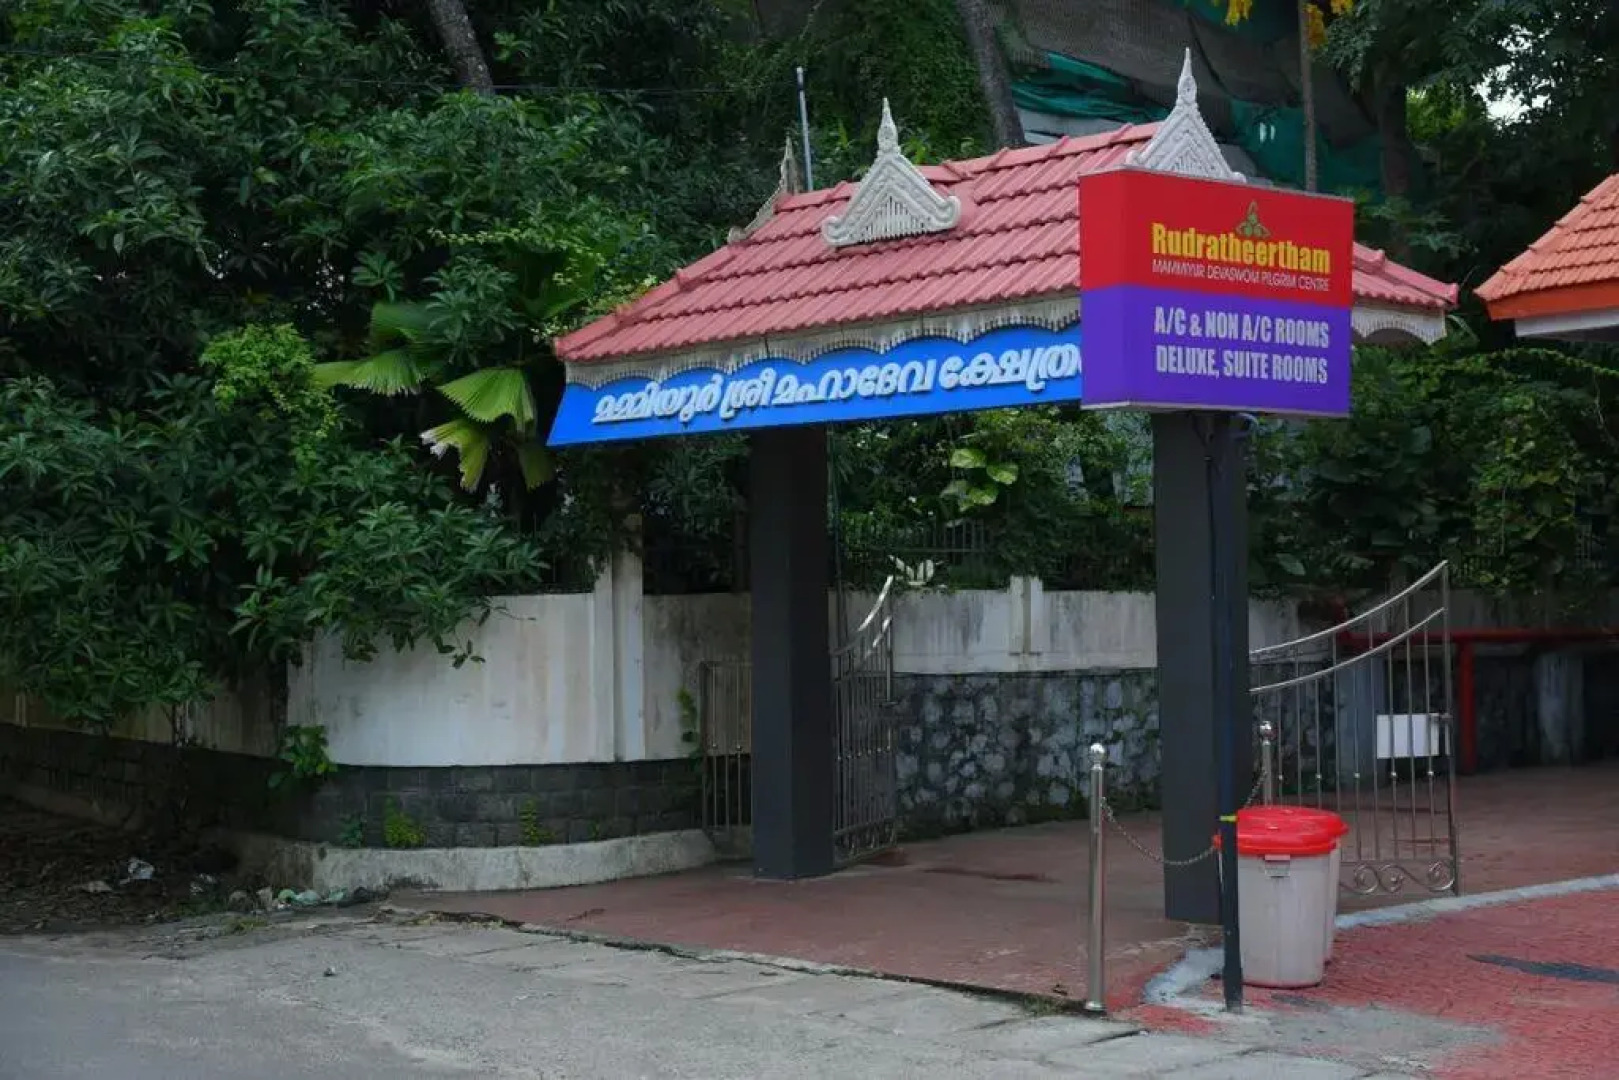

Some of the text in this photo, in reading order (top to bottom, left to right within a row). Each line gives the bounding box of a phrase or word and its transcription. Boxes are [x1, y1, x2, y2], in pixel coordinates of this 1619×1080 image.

[1152, 222, 1331, 274] Rudratheertham
[1207, 265, 1260, 284] DEVASWOM
[1261, 272, 1297, 288] PILGRIM
[1297, 276, 1329, 291] CENTRE
[1154, 306, 1329, 348] A/C & NON A/C ROOMS
[720, 367, 776, 419] ശ്രീ
[772, 359, 937, 405] മഹാദേവ
[938, 343, 1082, 392] ക്ഷേത്ര
[1156, 345, 1328, 384] DELUXE, SUITE ROOMS
